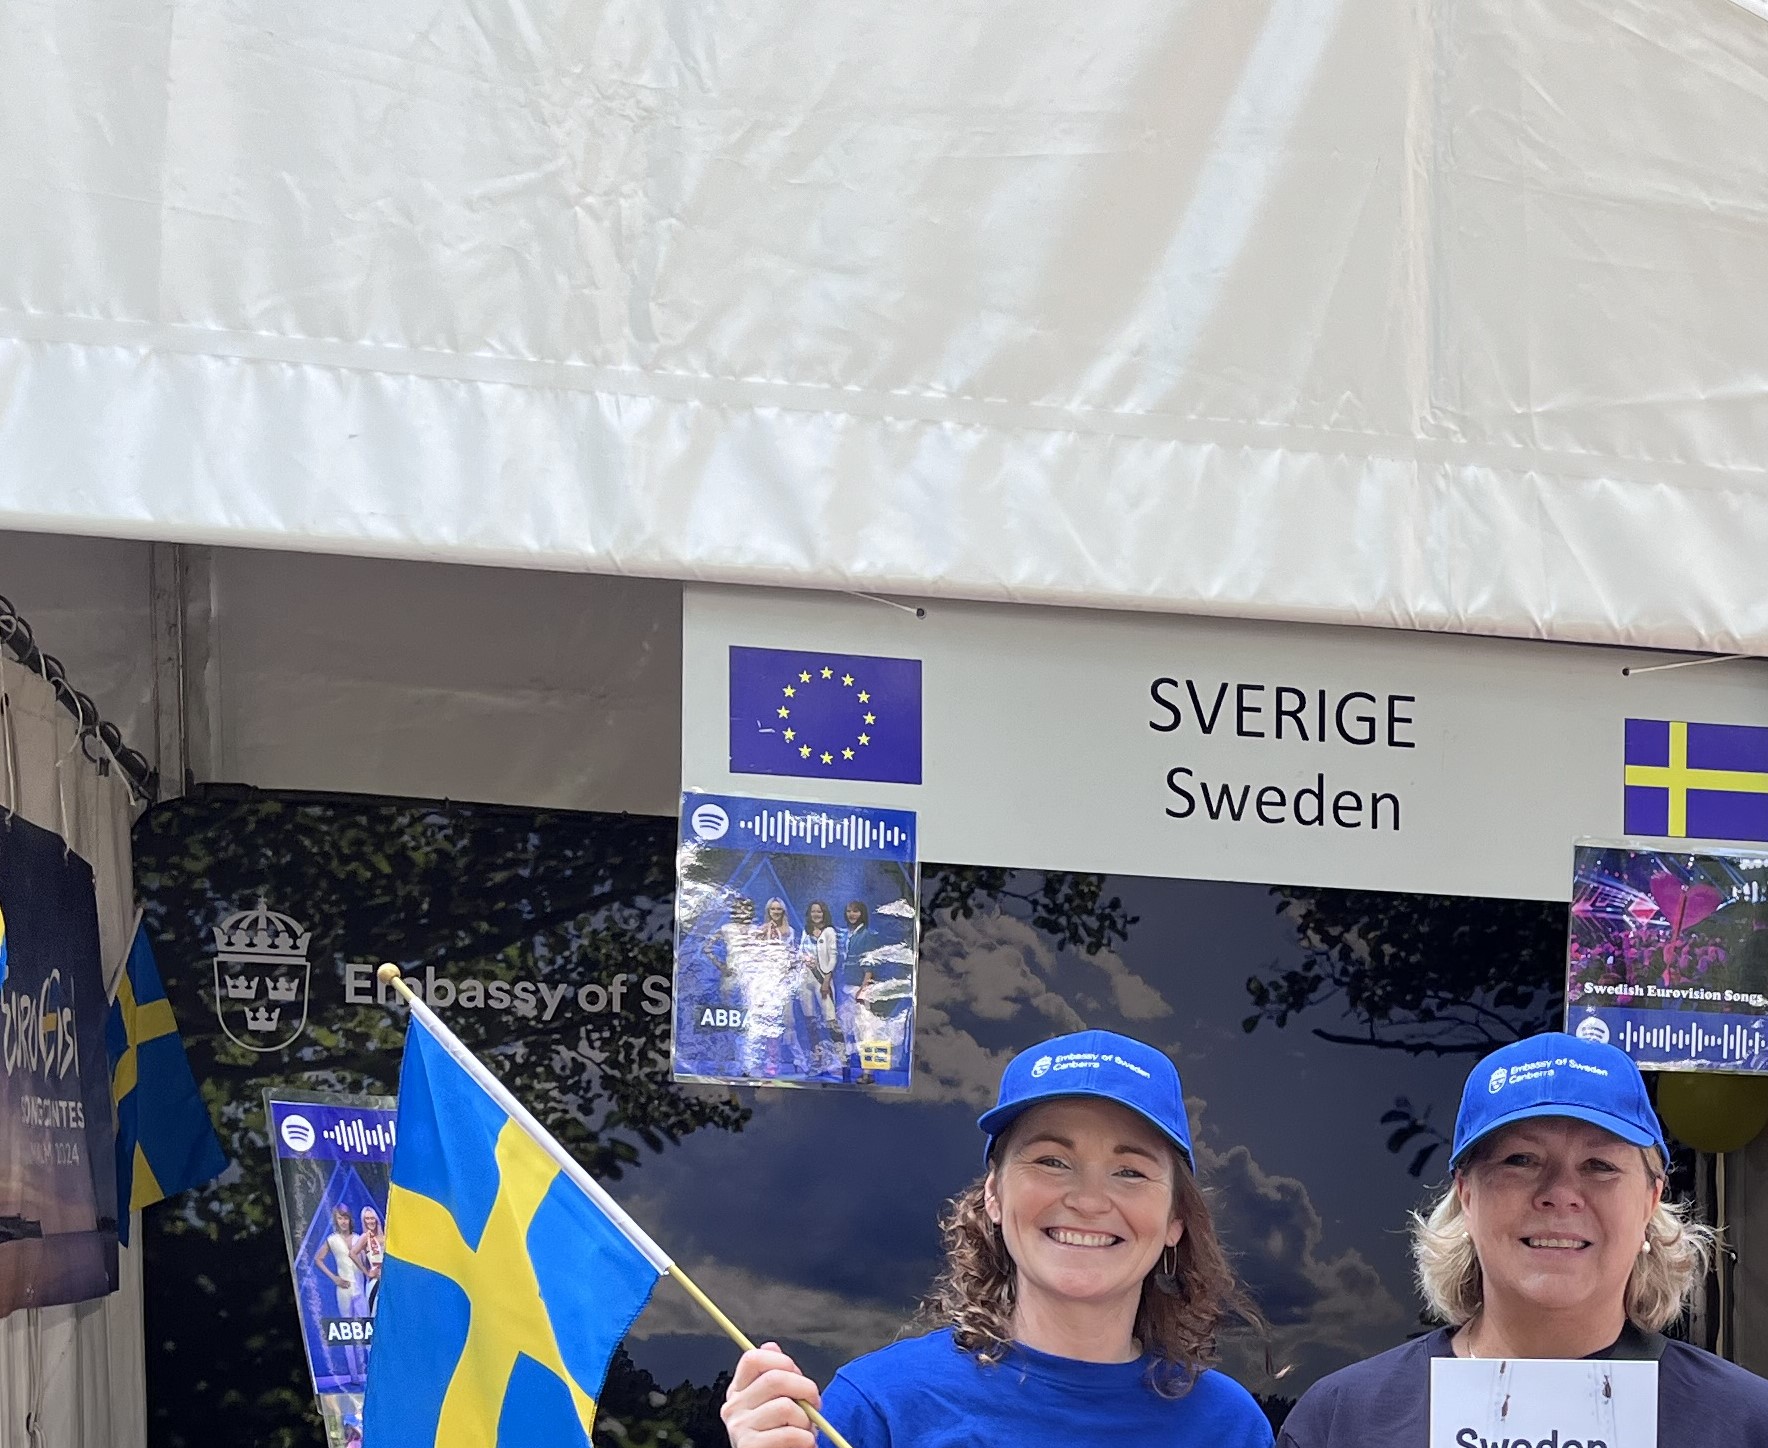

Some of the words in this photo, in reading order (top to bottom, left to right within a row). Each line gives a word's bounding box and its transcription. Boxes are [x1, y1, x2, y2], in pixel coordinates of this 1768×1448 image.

[1149, 677, 1416, 748] SVERIGE
[1165, 766, 1400, 831] Sweden
[577, 973, 628, 1014] of
[640, 974, 671, 1015] S
[1583, 982, 1644, 997] Swedish
[1647, 985, 1721, 1001] Eurovision
[1724, 990, 1764, 1007] Songs
[1053, 1061, 1100, 1071] Canberra
[1055, 1053, 1099, 1063] Embassy
[1114, 1056, 1150, 1079] Sweden
[1509, 1069, 1555, 1084] Canberra
[1510, 1060, 1552, 1075] Embassy
[1555, 1058, 1567, 1066] of
[1569, 1059, 1608, 1077] Sweden
[328, 1321, 374, 1342] ABBA
